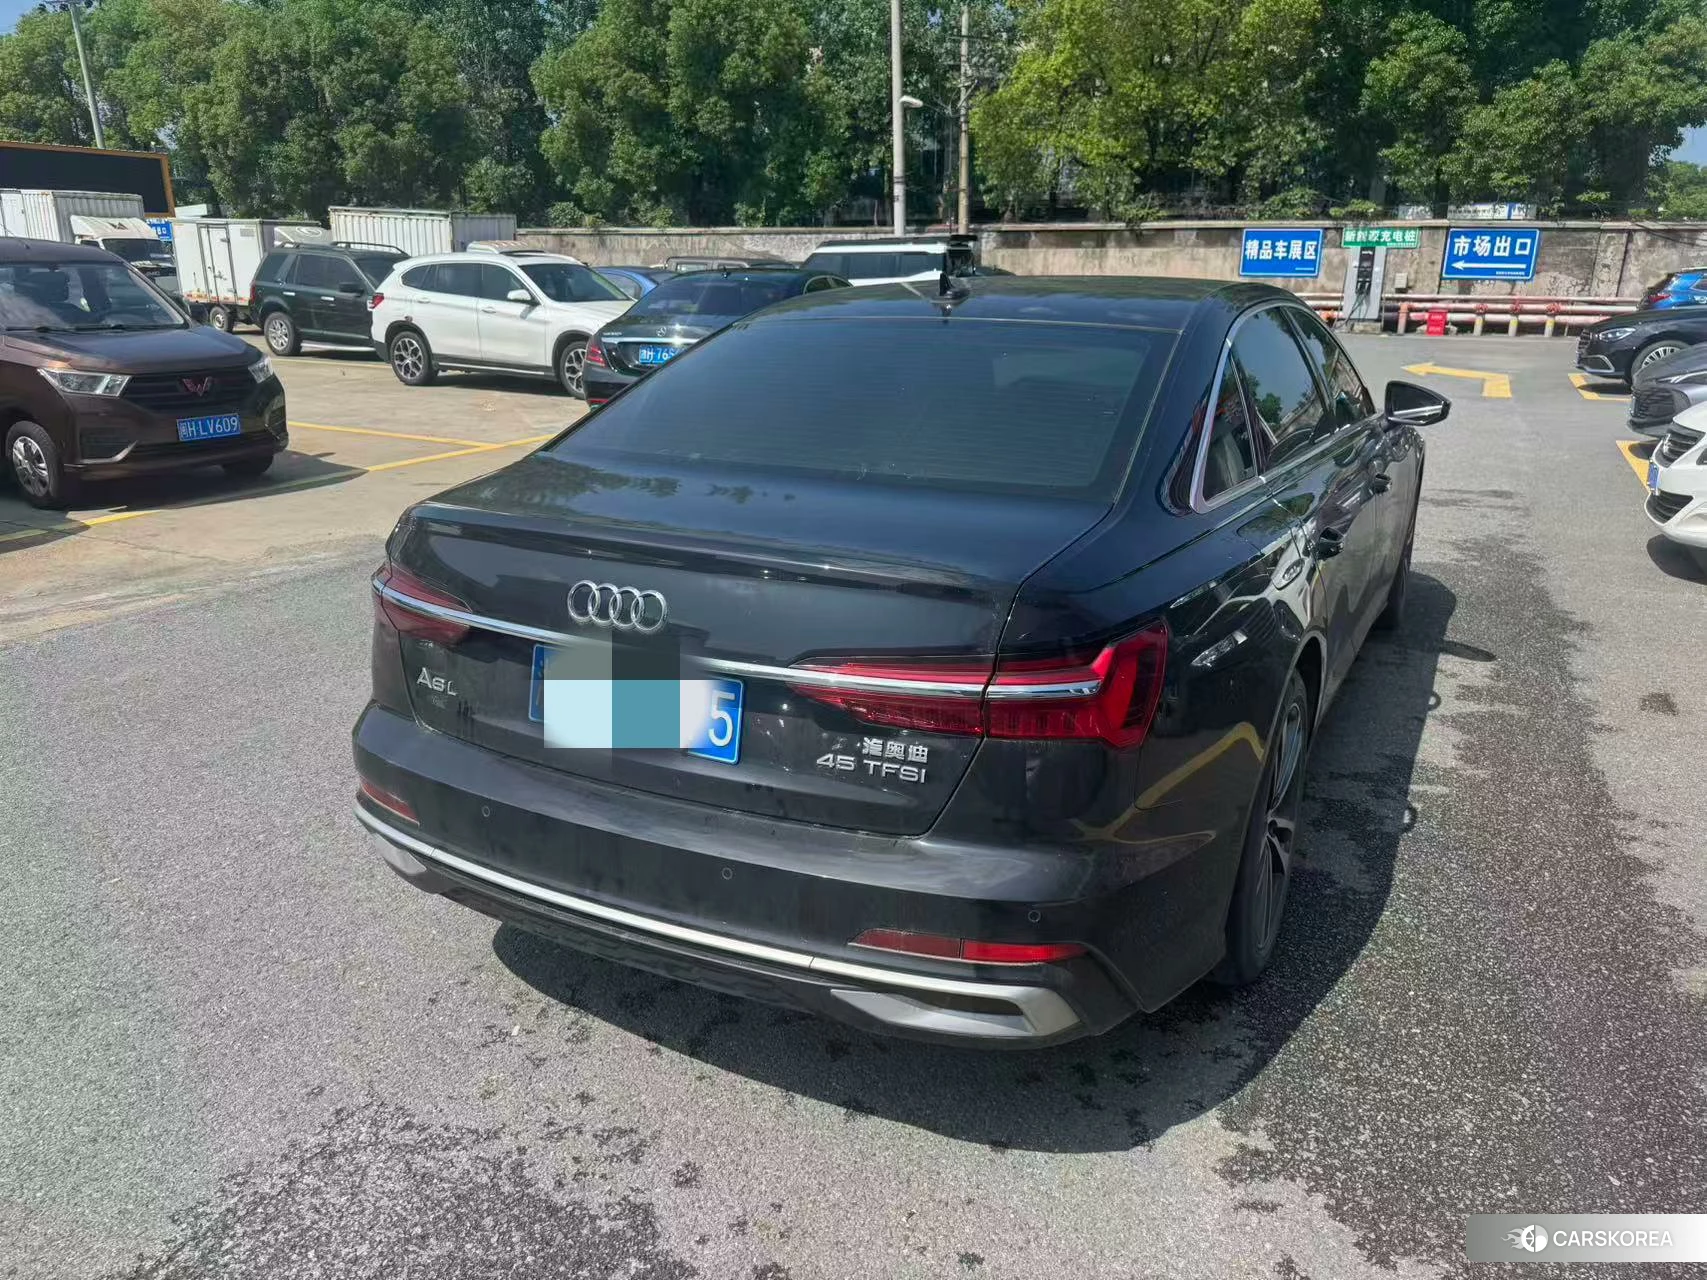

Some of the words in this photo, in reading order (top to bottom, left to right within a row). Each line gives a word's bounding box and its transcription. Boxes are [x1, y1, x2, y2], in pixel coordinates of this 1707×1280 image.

[1245, 239, 1317, 261] 精品车展区
[1453, 234, 1532, 257] 市场出口
[416, 667, 458, 697] A6L
[816, 753, 856, 771] 45
[863, 759, 926, 784] TFSI
